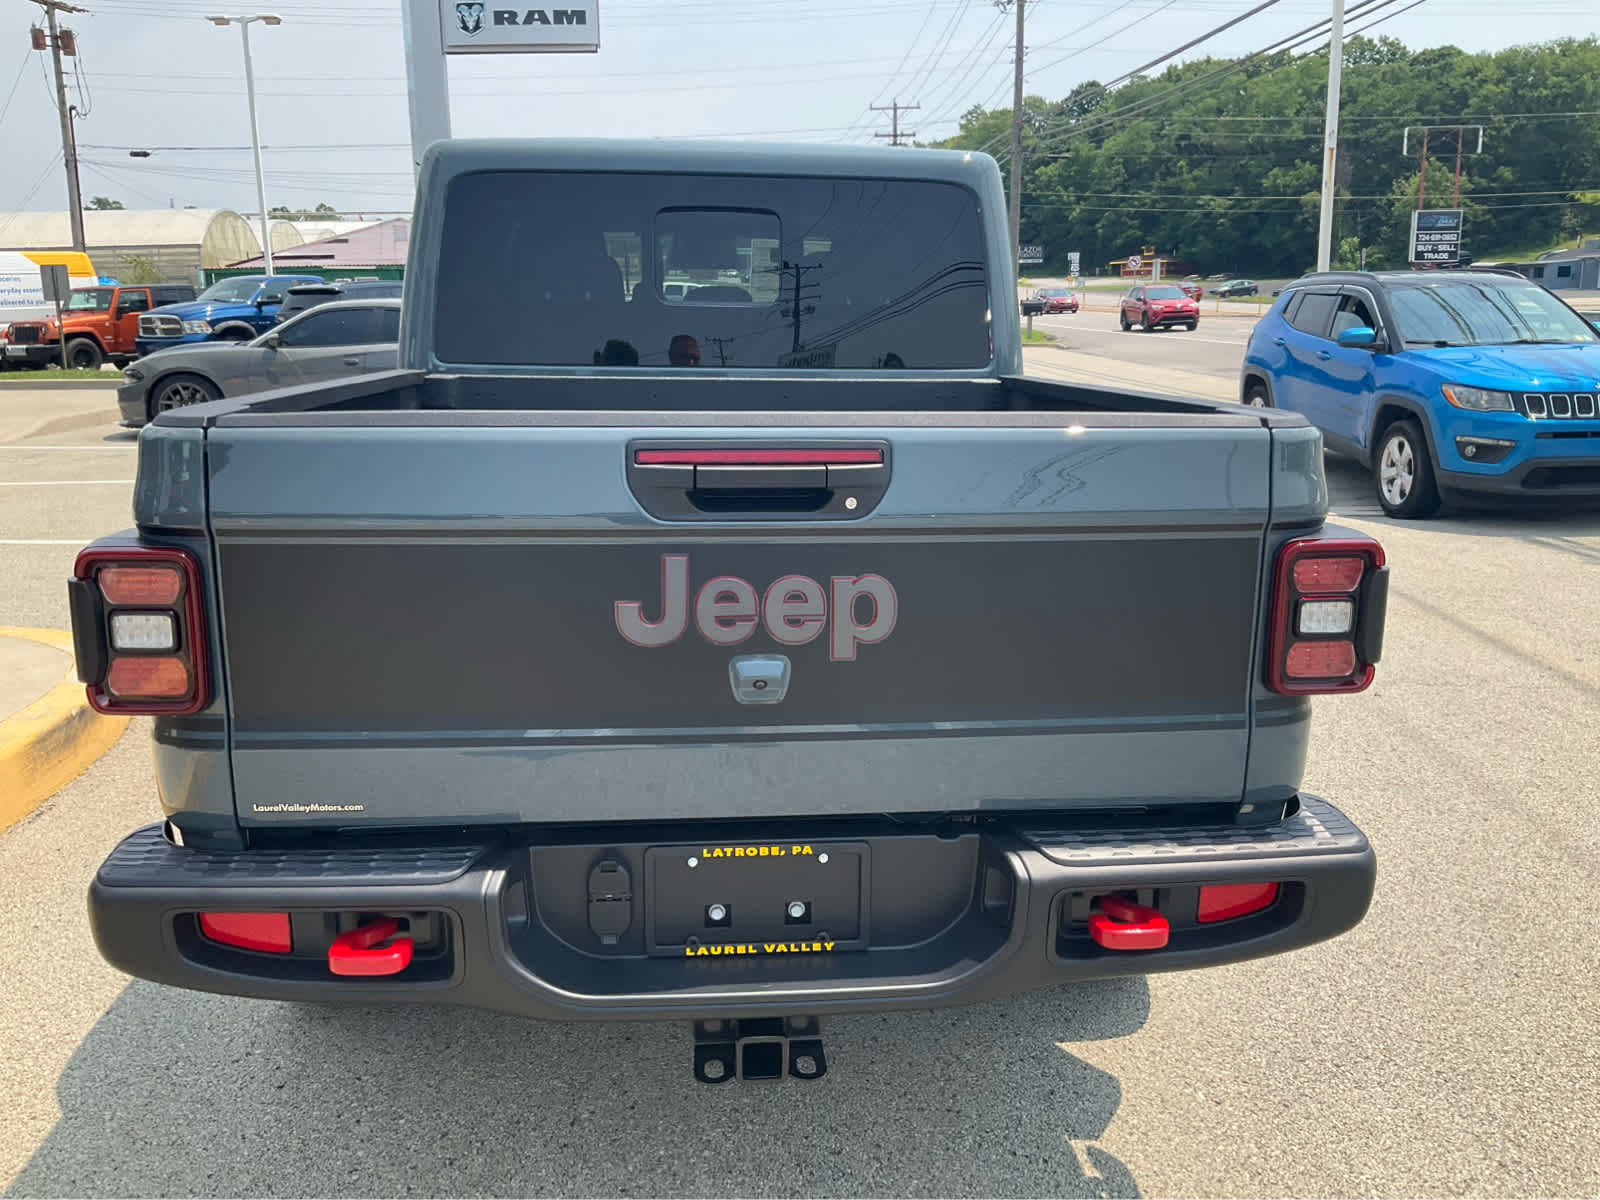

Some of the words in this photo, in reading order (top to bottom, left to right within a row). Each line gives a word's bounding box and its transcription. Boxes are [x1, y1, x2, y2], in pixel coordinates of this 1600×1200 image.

[493, 10, 587, 25] RAM
[615, 553, 898, 661] Jeep
[253, 804, 364, 813] LaurelValleyMotors.com
[703, 846, 785, 858] LATROBE,
[792, 845, 813, 855] PA
[685, 944, 758, 956] LAUREL
[764, 942, 835, 953] VALLEY
